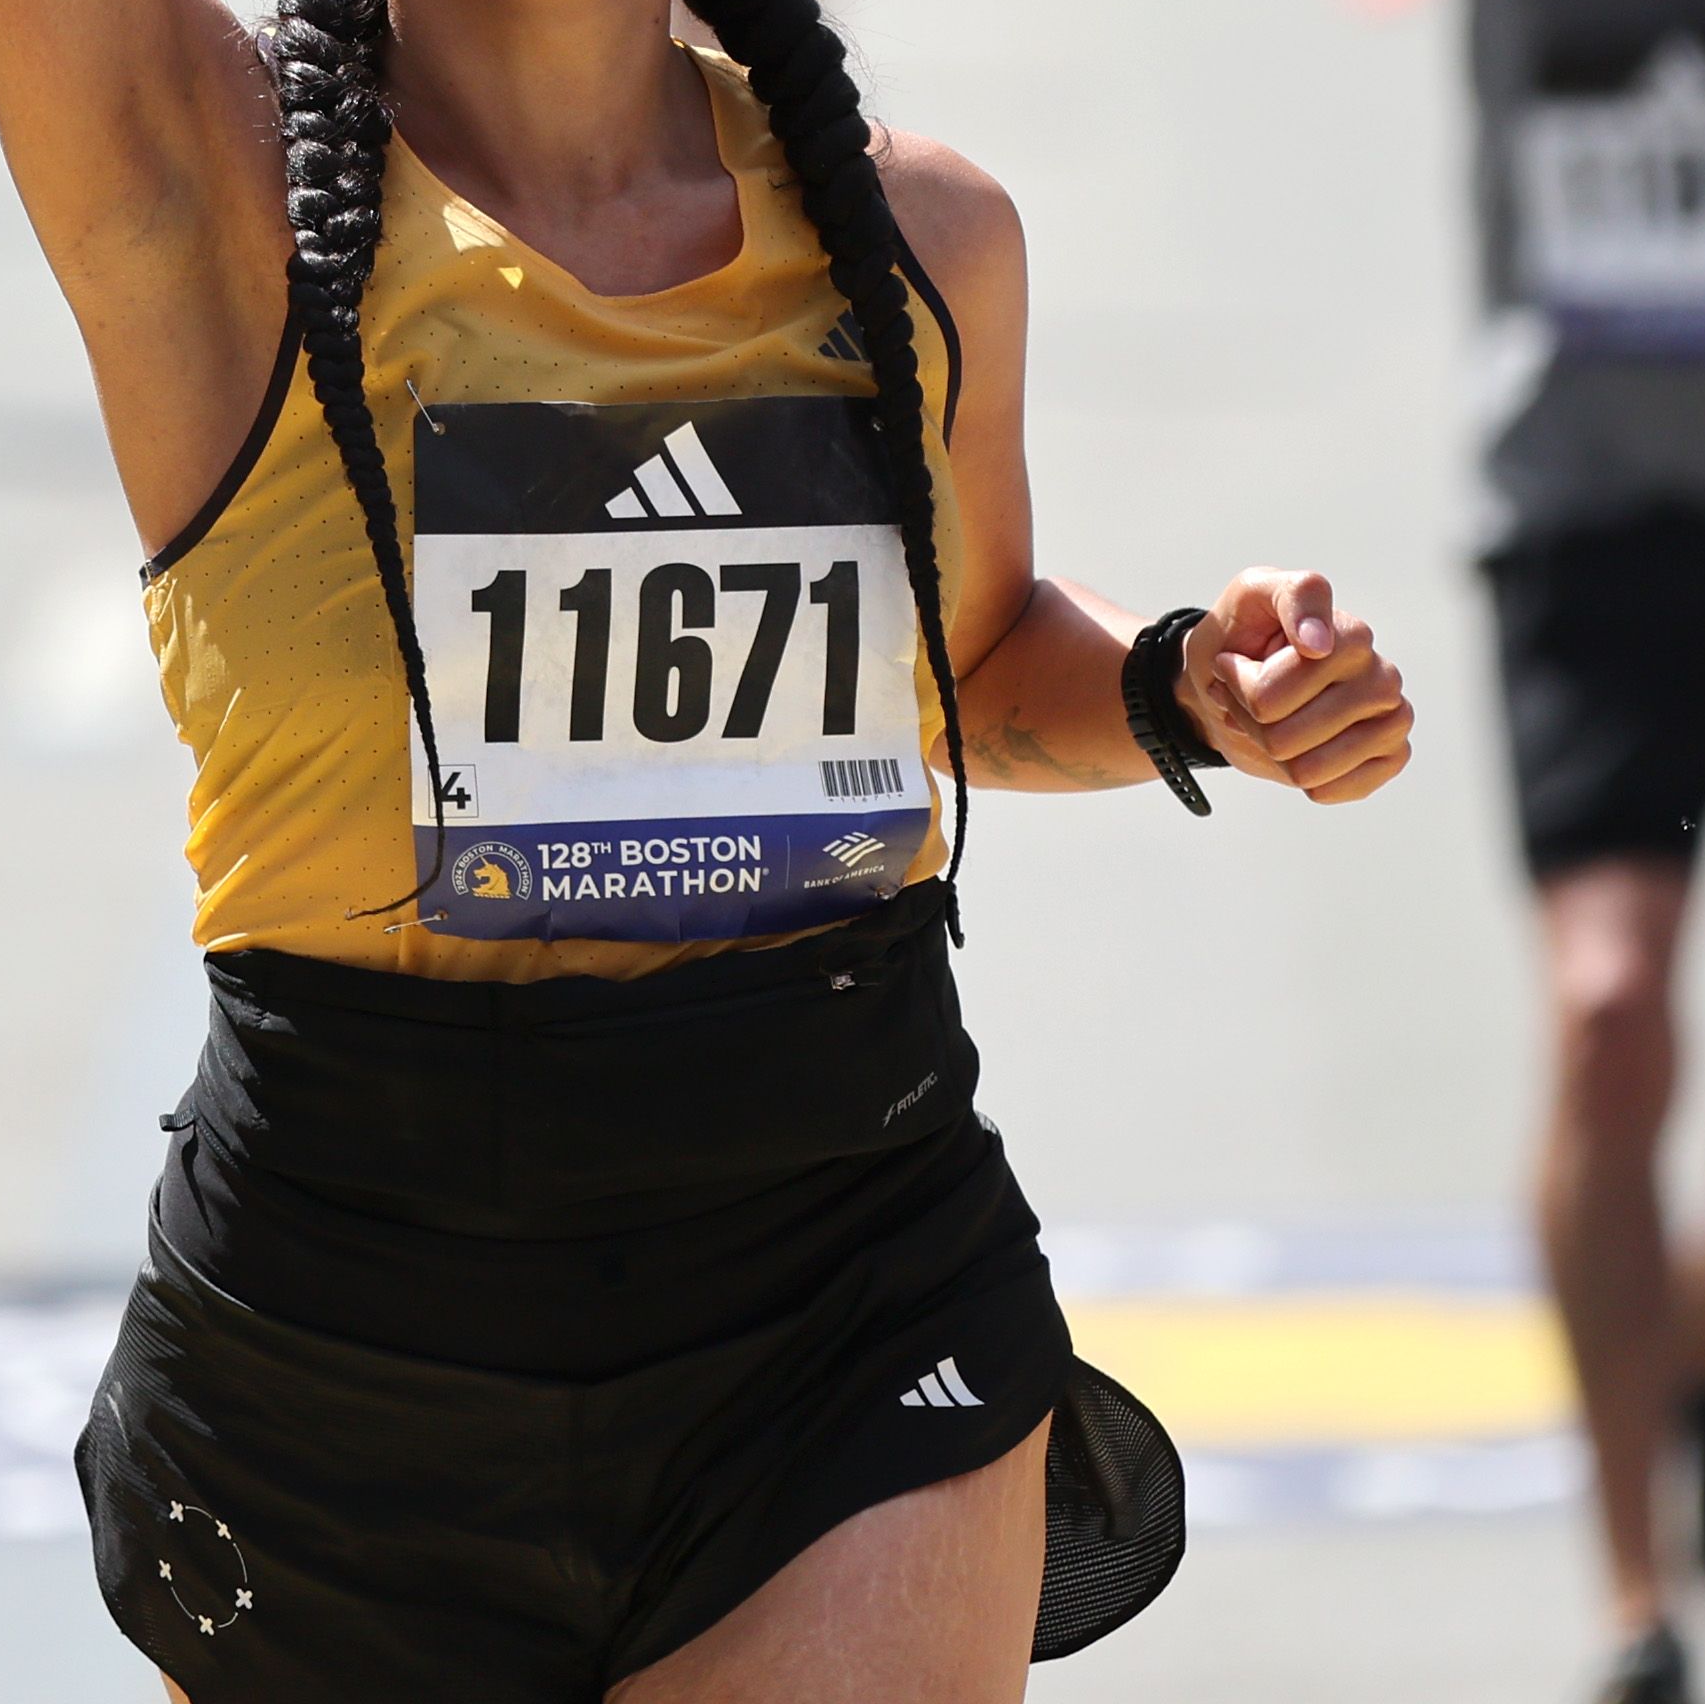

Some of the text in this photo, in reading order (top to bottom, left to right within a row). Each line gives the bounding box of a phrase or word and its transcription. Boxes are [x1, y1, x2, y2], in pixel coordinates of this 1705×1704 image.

[471, 560, 860, 744] 11671
[438, 771, 471, 810] 4
[619, 835, 762, 866] BOSTON
[455, 844, 530, 894] 2024 BOSTON MARATHON
[542, 867, 762, 901] MARATHON
[803, 878, 830, 889] BANK
[845, 864, 885, 880] AMERICA
